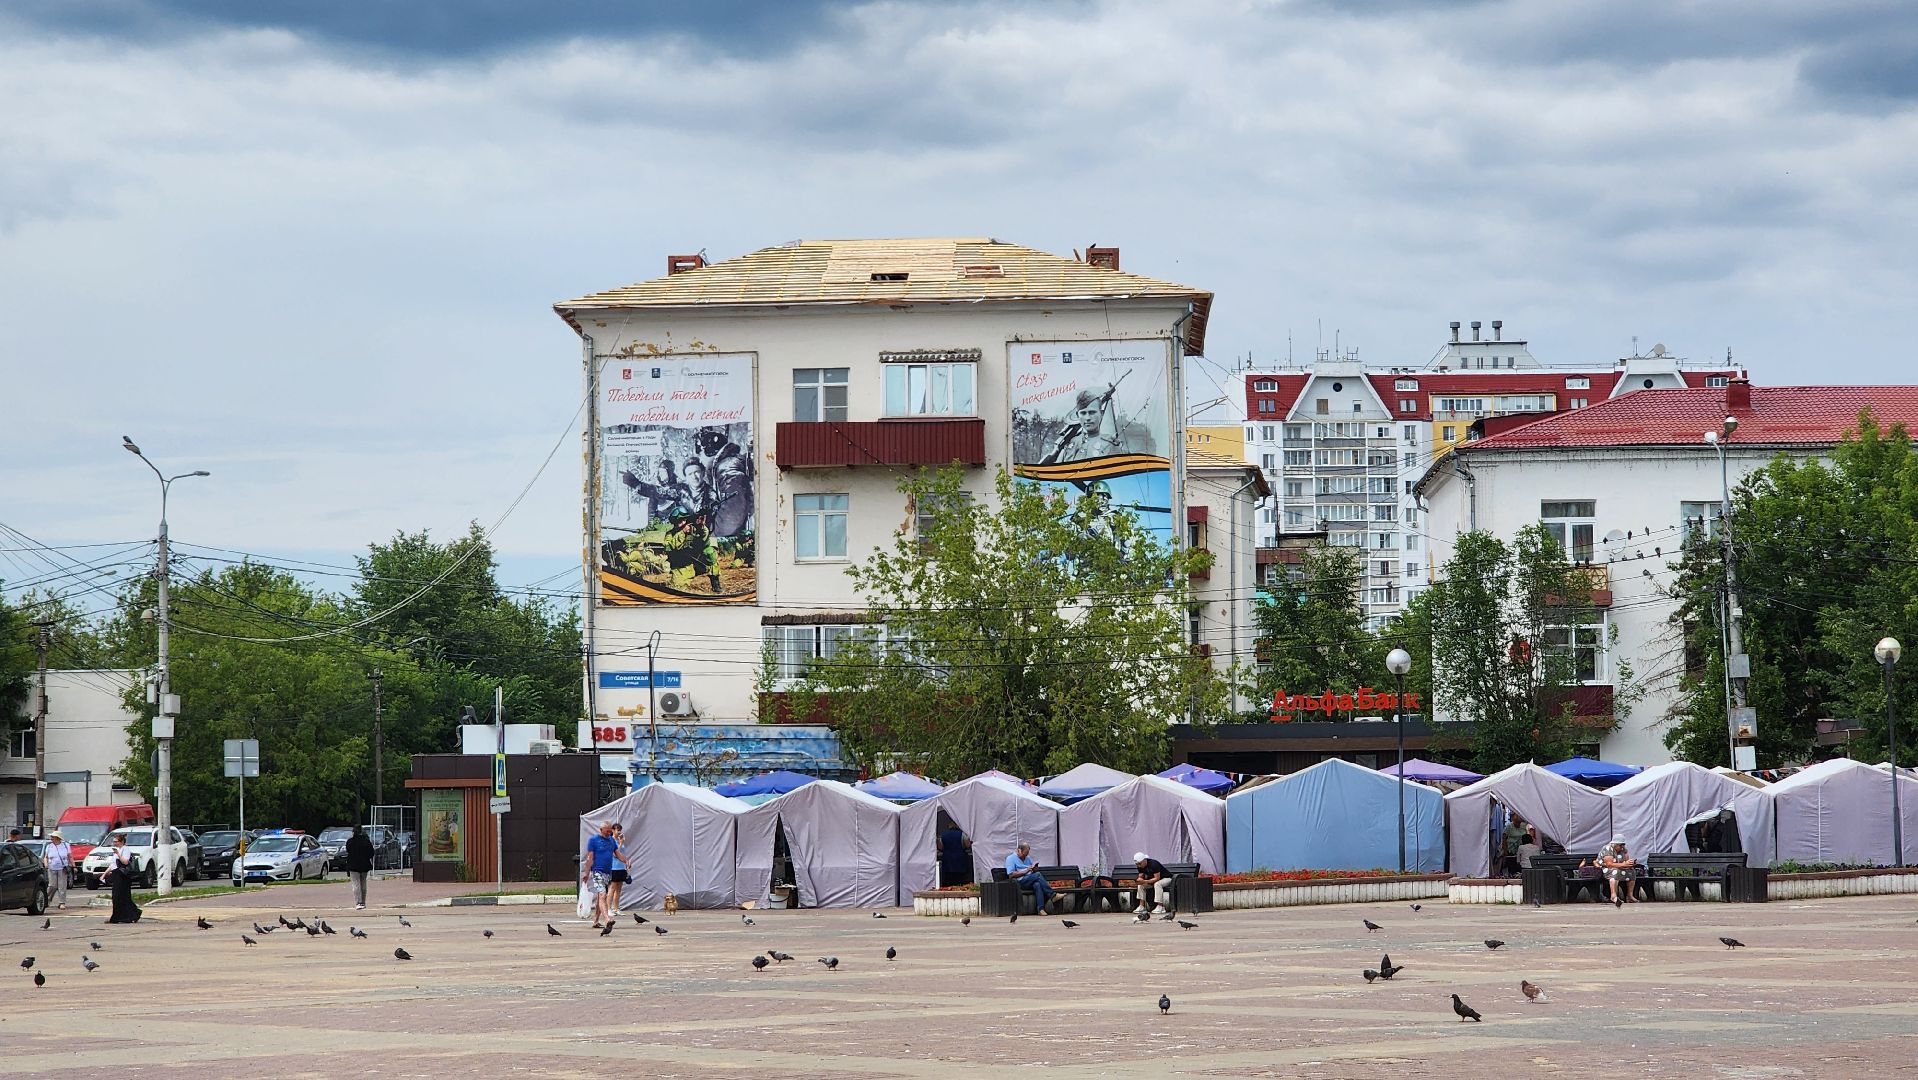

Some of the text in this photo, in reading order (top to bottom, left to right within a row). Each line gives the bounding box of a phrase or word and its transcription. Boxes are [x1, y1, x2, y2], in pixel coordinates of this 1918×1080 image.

[607, 386, 664, 402] Победили
[670, 384, 708, 401] тогда
[1021, 380, 1077, 405] поколений
[630, 406, 745, 421] победим и сейчас!
[1270, 689, 1354, 717] Альфа
[593, 726, 627, 743] 585
